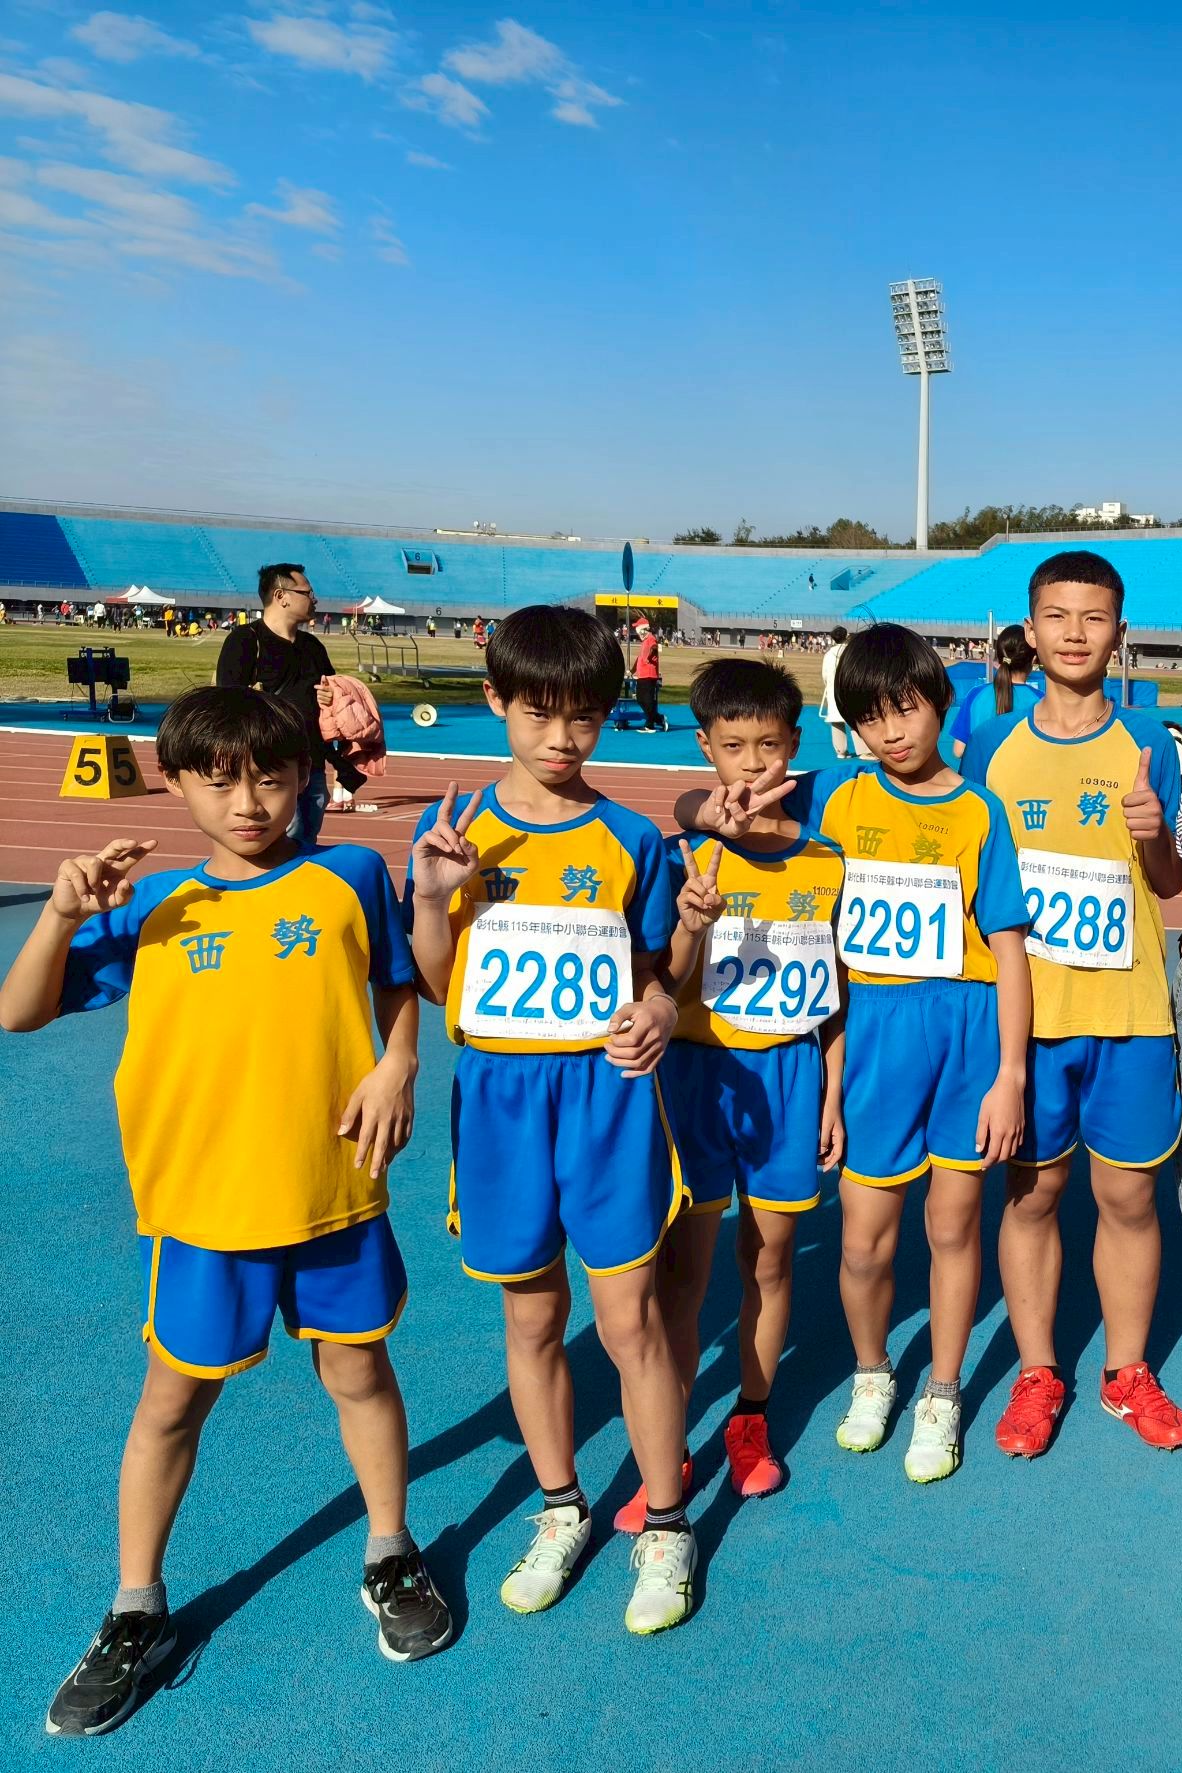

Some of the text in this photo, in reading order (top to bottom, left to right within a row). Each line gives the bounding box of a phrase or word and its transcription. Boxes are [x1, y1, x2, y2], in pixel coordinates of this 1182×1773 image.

[415, 552, 421, 561] 6
[436, 607, 442, 616] 6
[74, 747, 102, 787] 5
[112, 747, 136, 786] 5
[476, 918, 628, 939] 彰化縣115年縣中小聯合運動會
[843, 897, 947, 960] 2291
[1024, 887, 1127, 953] 2288
[475, 948, 619, 1021] 2289
[712, 955, 831, 1018] 2292
